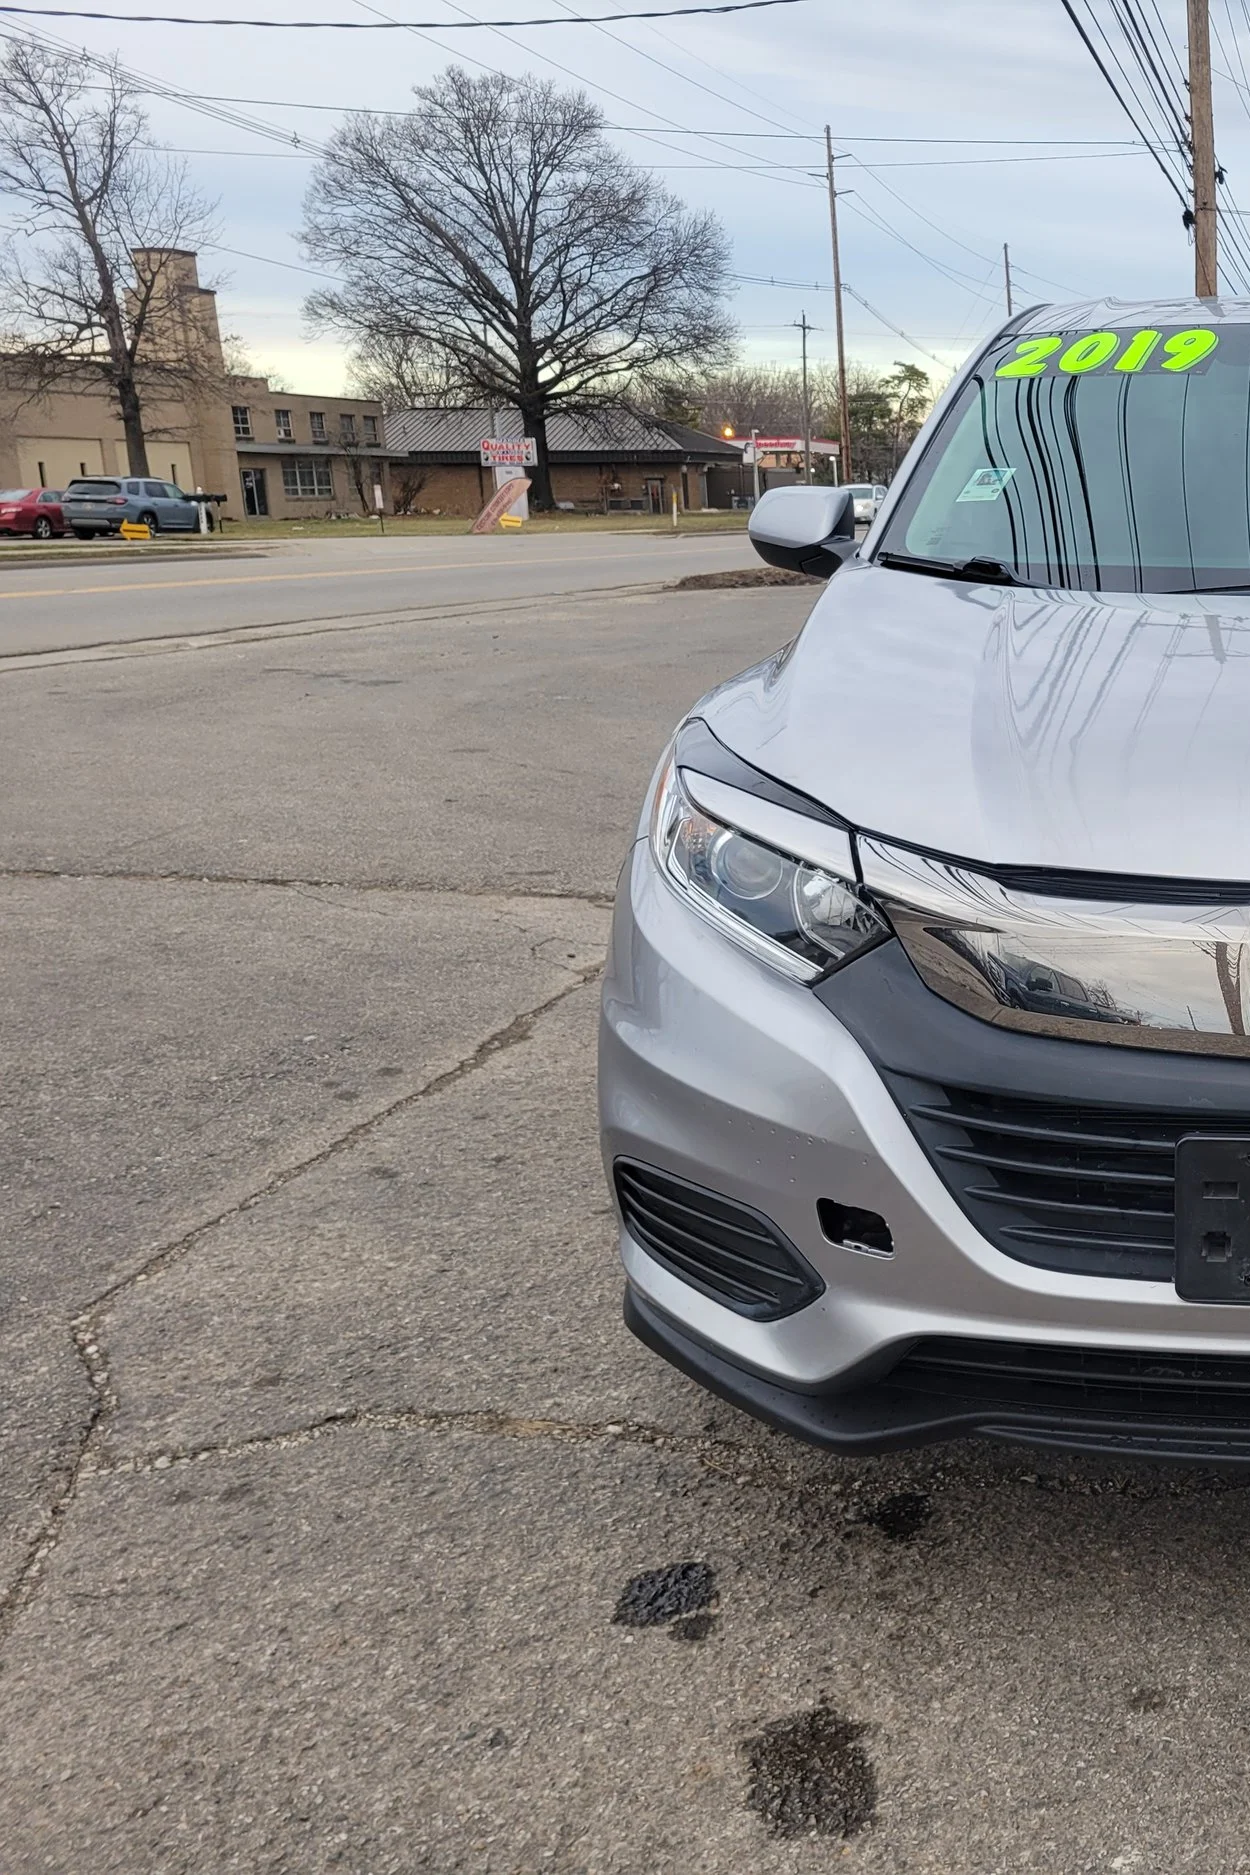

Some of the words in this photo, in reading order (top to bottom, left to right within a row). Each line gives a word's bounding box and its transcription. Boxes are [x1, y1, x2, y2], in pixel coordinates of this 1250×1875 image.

[995, 329, 1219, 379] 2019
[482, 440, 531, 451] QUALITY
[491, 454, 524, 463] TIRES
